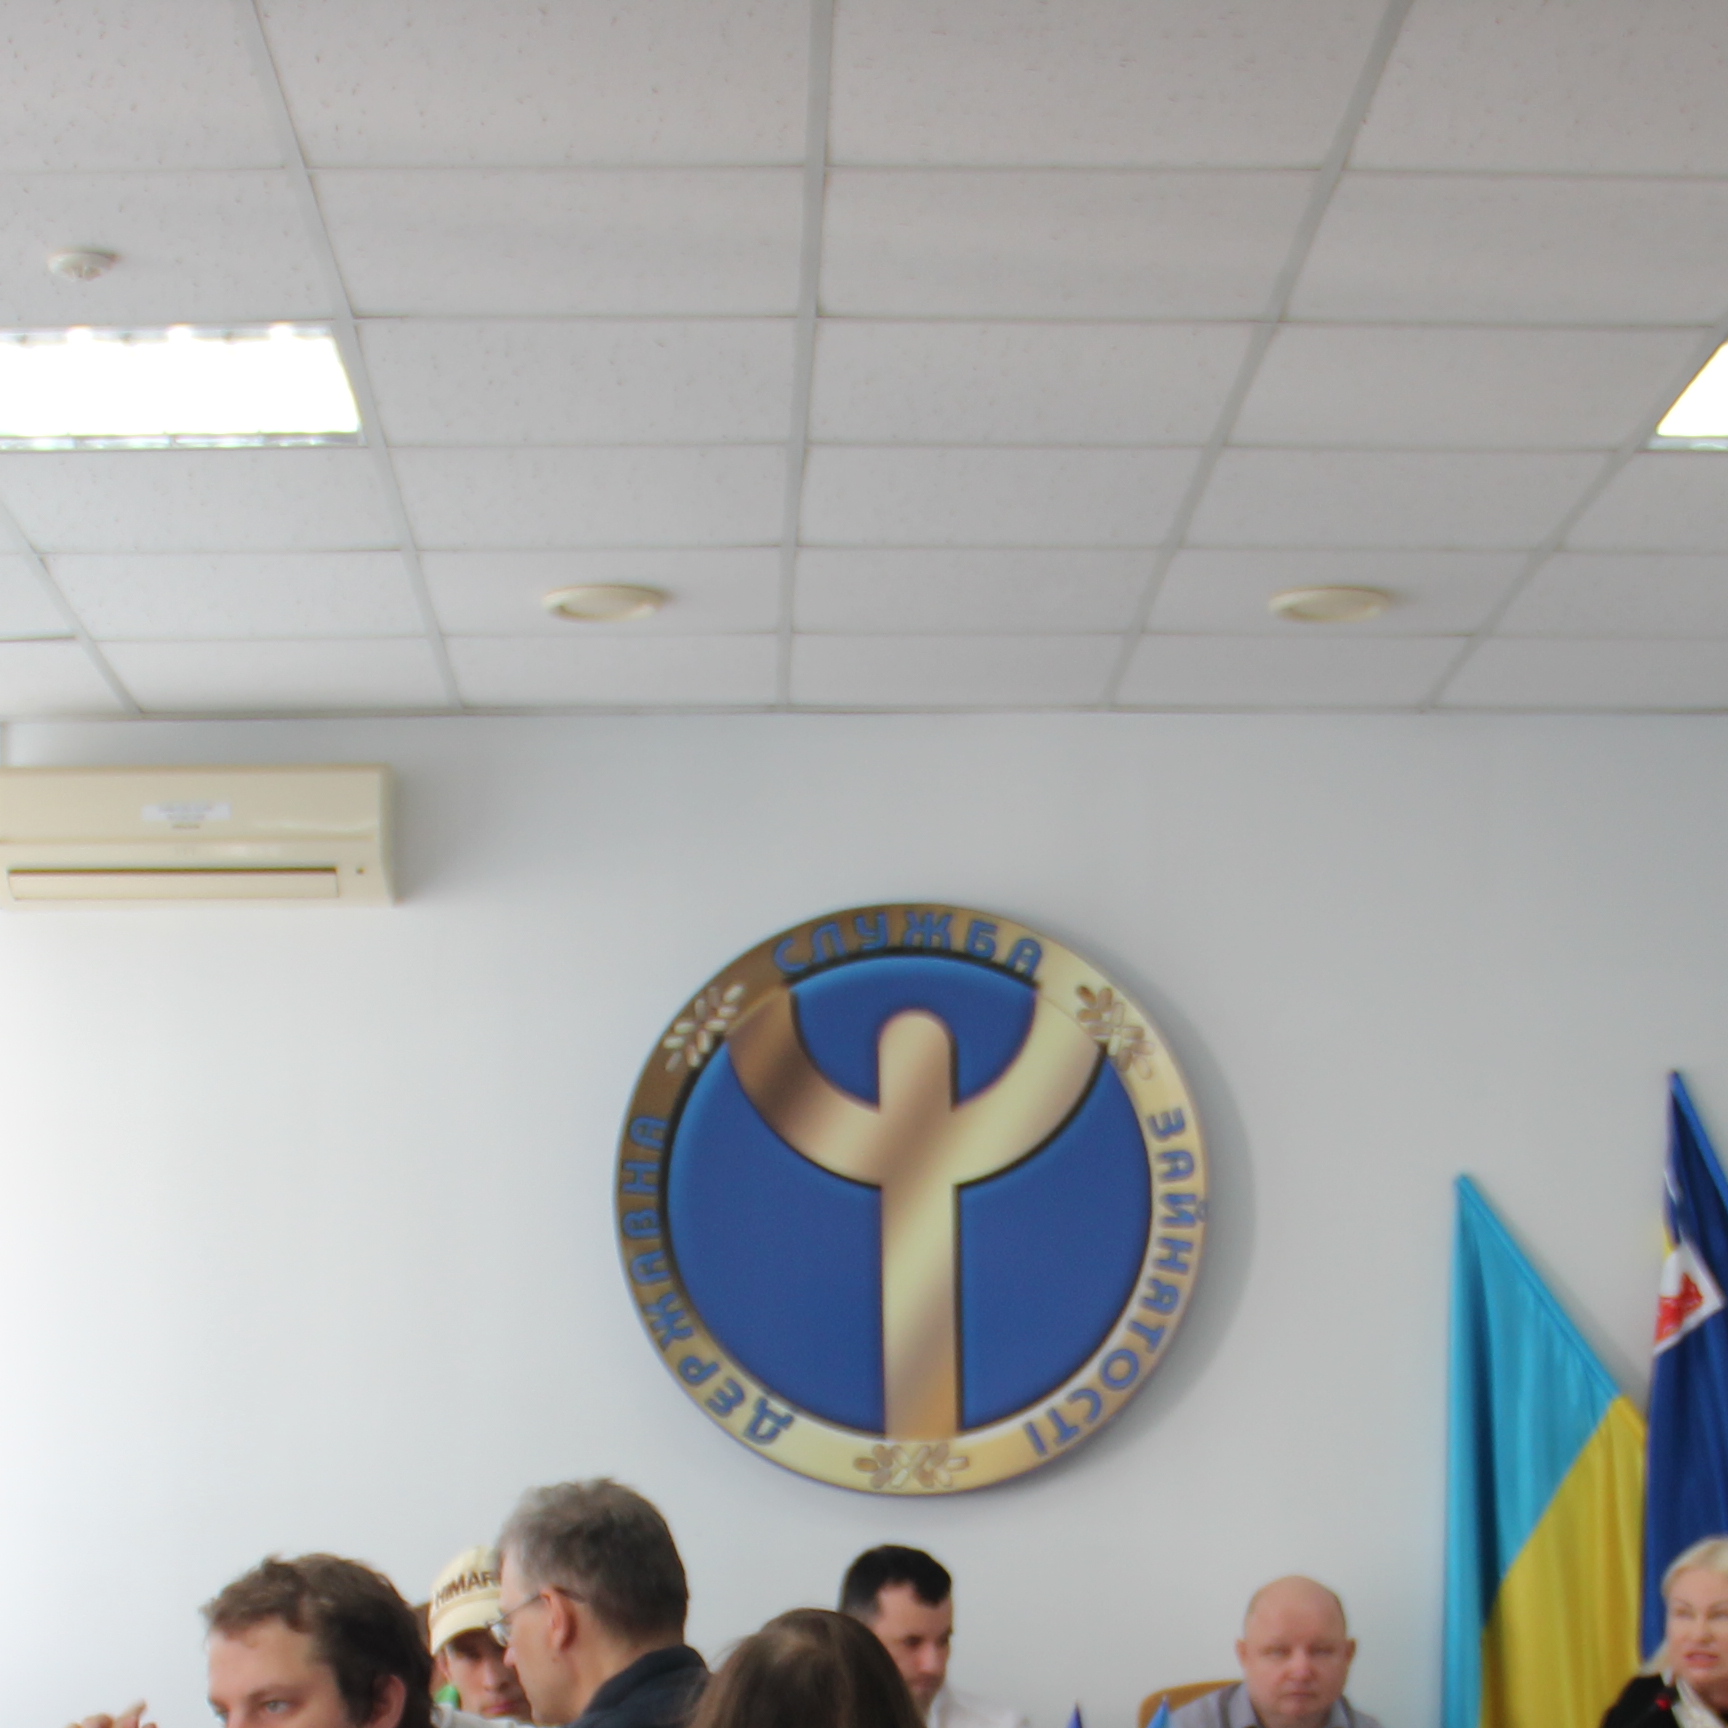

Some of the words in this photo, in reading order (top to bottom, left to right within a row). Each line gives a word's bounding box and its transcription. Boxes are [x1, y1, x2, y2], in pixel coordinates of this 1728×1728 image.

[623, 1113, 795, 1446] ДЕРЖАВНА
[772, 909, 1044, 978] СЛУЖБА
[1023, 1106, 1207, 1457] ЗАЙНЯТОСТІ
[434, 1570, 499, 1609] HIMAR
